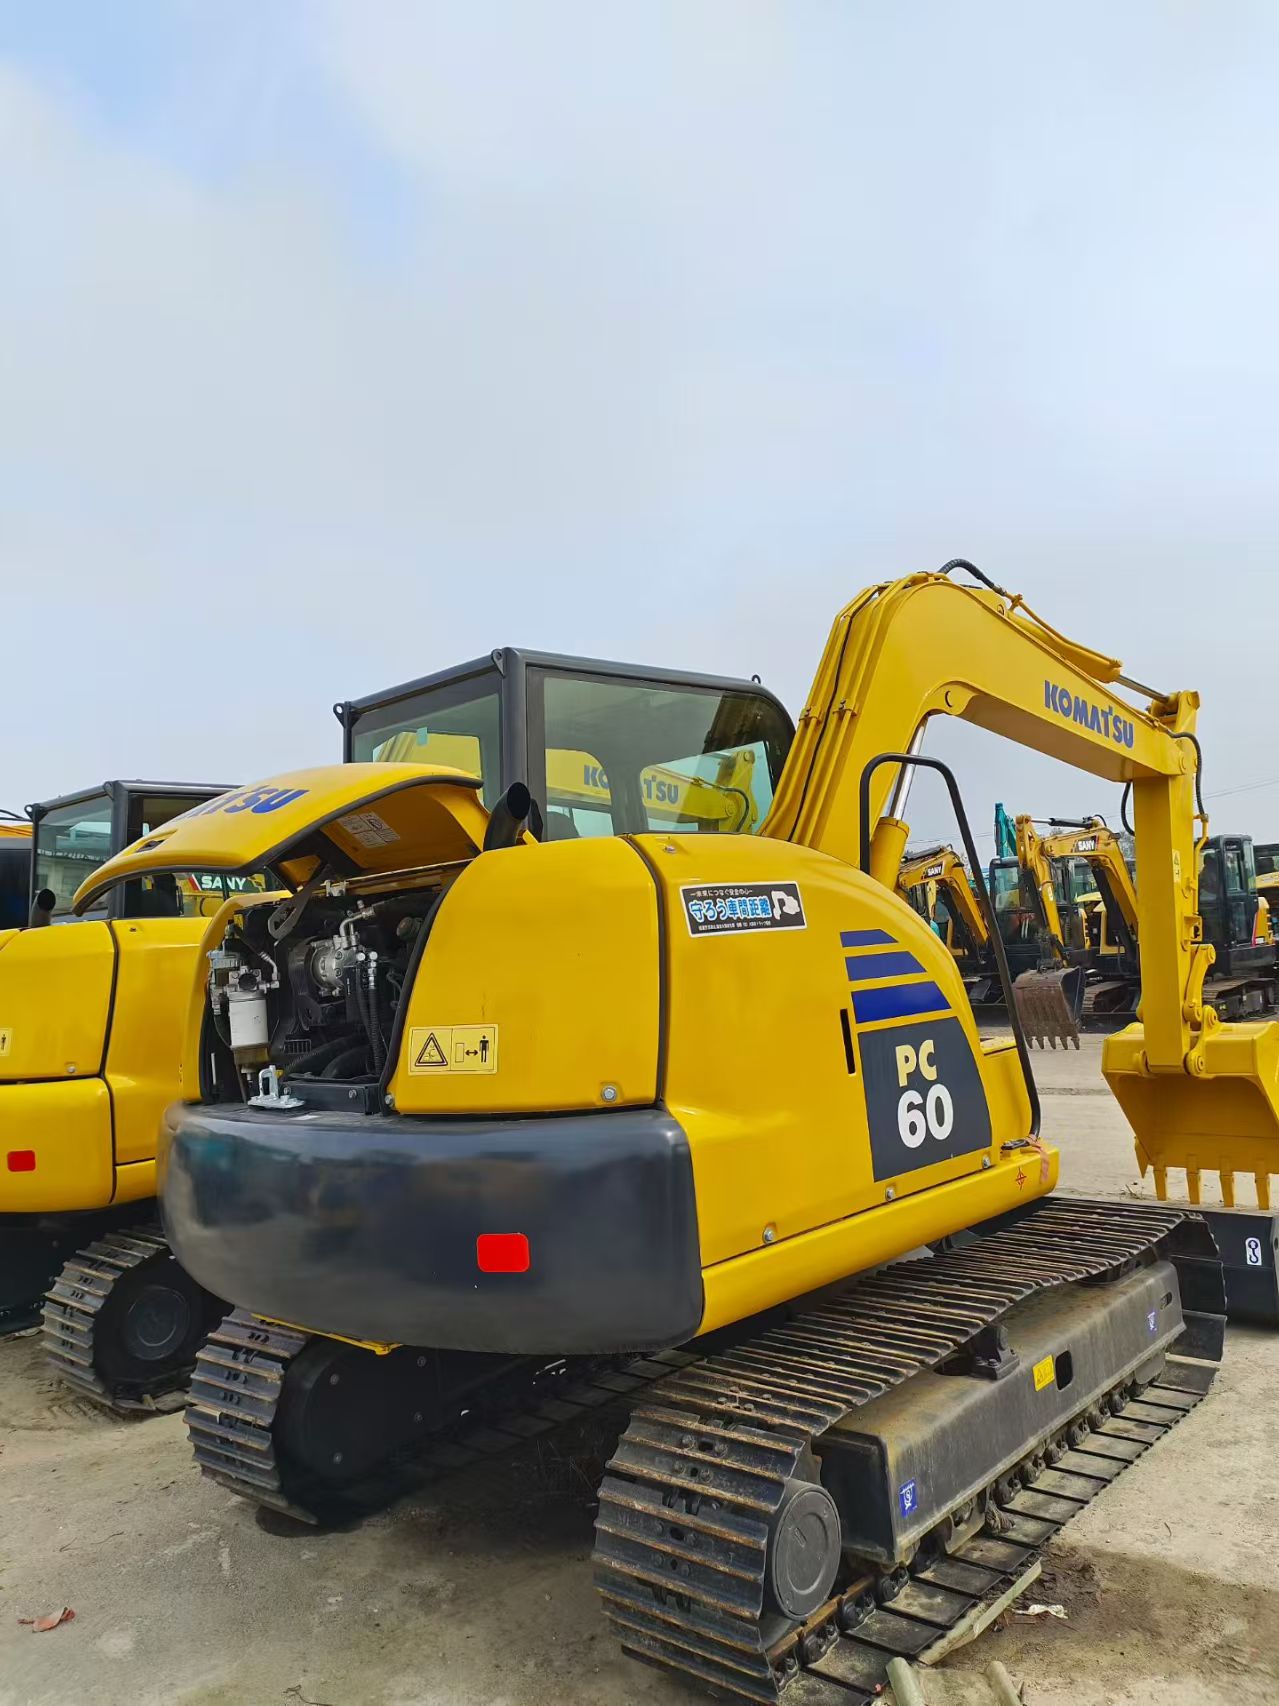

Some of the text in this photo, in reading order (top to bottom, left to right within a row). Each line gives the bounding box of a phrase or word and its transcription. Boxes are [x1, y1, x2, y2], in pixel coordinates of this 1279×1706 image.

[1045, 680, 1133, 749] KOMATSU
[584, 765, 678, 804] KOTSU
[201, 875, 246, 890] SANY
[689, 896, 772, 923] 守ろう車間距離
[895, 1039, 938, 1087] PC
[897, 1083, 954, 1149] 60
